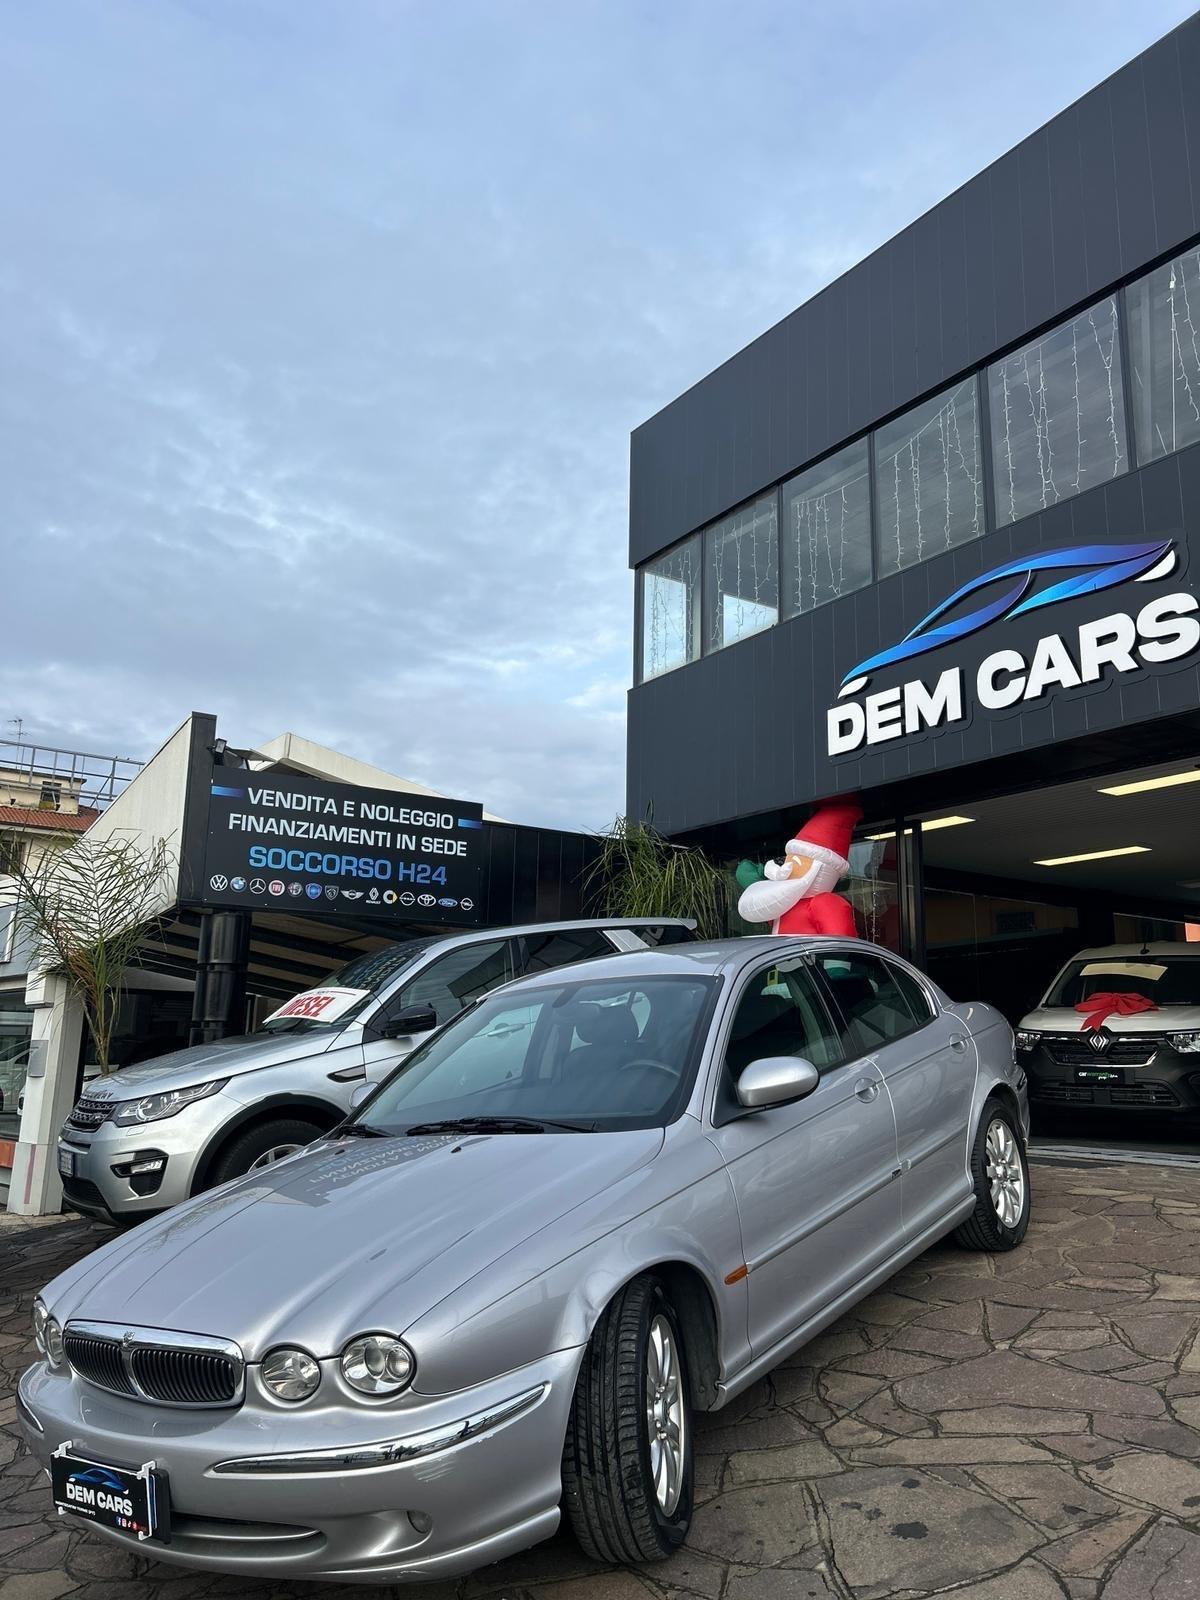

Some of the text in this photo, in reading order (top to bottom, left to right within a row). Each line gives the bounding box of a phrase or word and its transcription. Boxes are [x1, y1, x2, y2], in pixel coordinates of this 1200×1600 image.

[827, 592, 1200, 756] DEM CARS
[248, 787, 454, 830] VENDITA E NOLEGGIO
[228, 813, 468, 857] FINANZIAMENTI IN SEDE
[249, 846, 447, 886] SOCCORSO H24
[66, 1483, 133, 1516] DEM CARS
